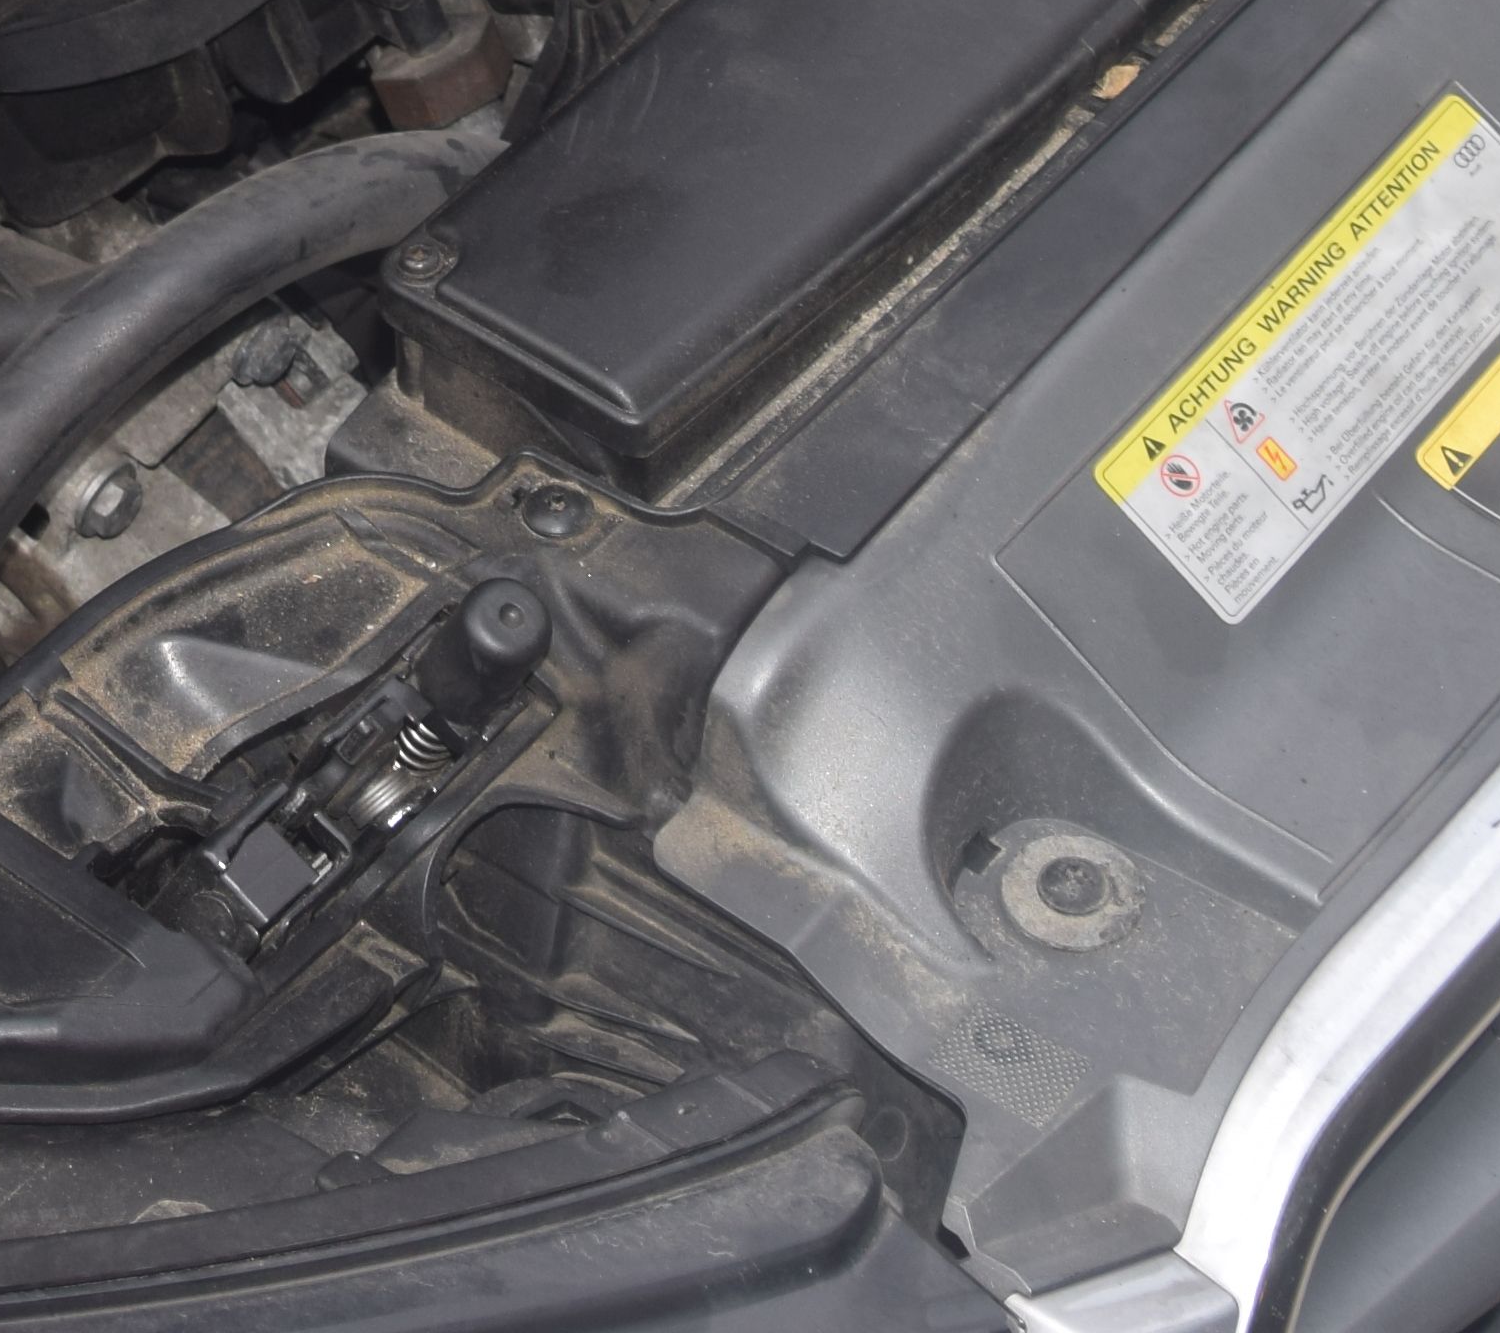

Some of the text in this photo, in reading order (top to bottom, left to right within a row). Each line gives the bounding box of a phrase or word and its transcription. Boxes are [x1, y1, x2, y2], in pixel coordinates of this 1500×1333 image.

[1163, 136, 1442, 436] ACHTUNG WARNING ATTENTION
[1343, 348, 1358, 364] vor
[1383, 303, 1398, 319] der
[1431, 243, 1453, 267] Motor
[1265, 353, 1297, 388] Radiator
[1293, 342, 1308, 358] fan
[1305, 327, 1323, 347] may
[1319, 310, 1337, 330] start
[1342, 290, 1358, 307] any
[1301, 405, 1323, 429] High
[1345, 352, 1370, 380] Switch
[1367, 341, 1380, 356] off
[1376, 318, 1403, 347] engine
[1397, 295, 1422, 322] before
[1418, 265, 1451, 301] touching
[1433, 322, 1449, 340] den
[1467, 321, 1487, 343] pour
[1274, 383, 1287, 398] Le
[1318, 331, 1337, 352] peut
[1333, 323, 1345, 335] se
[1311, 411, 1335, 437] Haute
[1378, 351, 1389, 363] le
[1385, 328, 1411, 356] moteur
[1408, 307, 1430, 331] avant
[1425, 297, 1438, 312] de
[1434, 271, 1462, 302] toucher
[1337, 426, 1374, 466] Overfilled
[1370, 403, 1397, 432] engine
[1391, 392, 1404, 407] oil
[1401, 380, 1416, 396] can
[1412, 350, 1442, 383] damage
[1168, 506, 1194, 535] Heiße
[1176, 505, 1212, 545] Bewegte
[1187, 535, 1206, 556] Hot
[1202, 511, 1231, 542] engine
[1229, 536, 1244, 552] du
[1240, 509, 1269, 541] moteur
[1196, 530, 1228, 566] Moving
[1247, 555, 1260, 570] en
